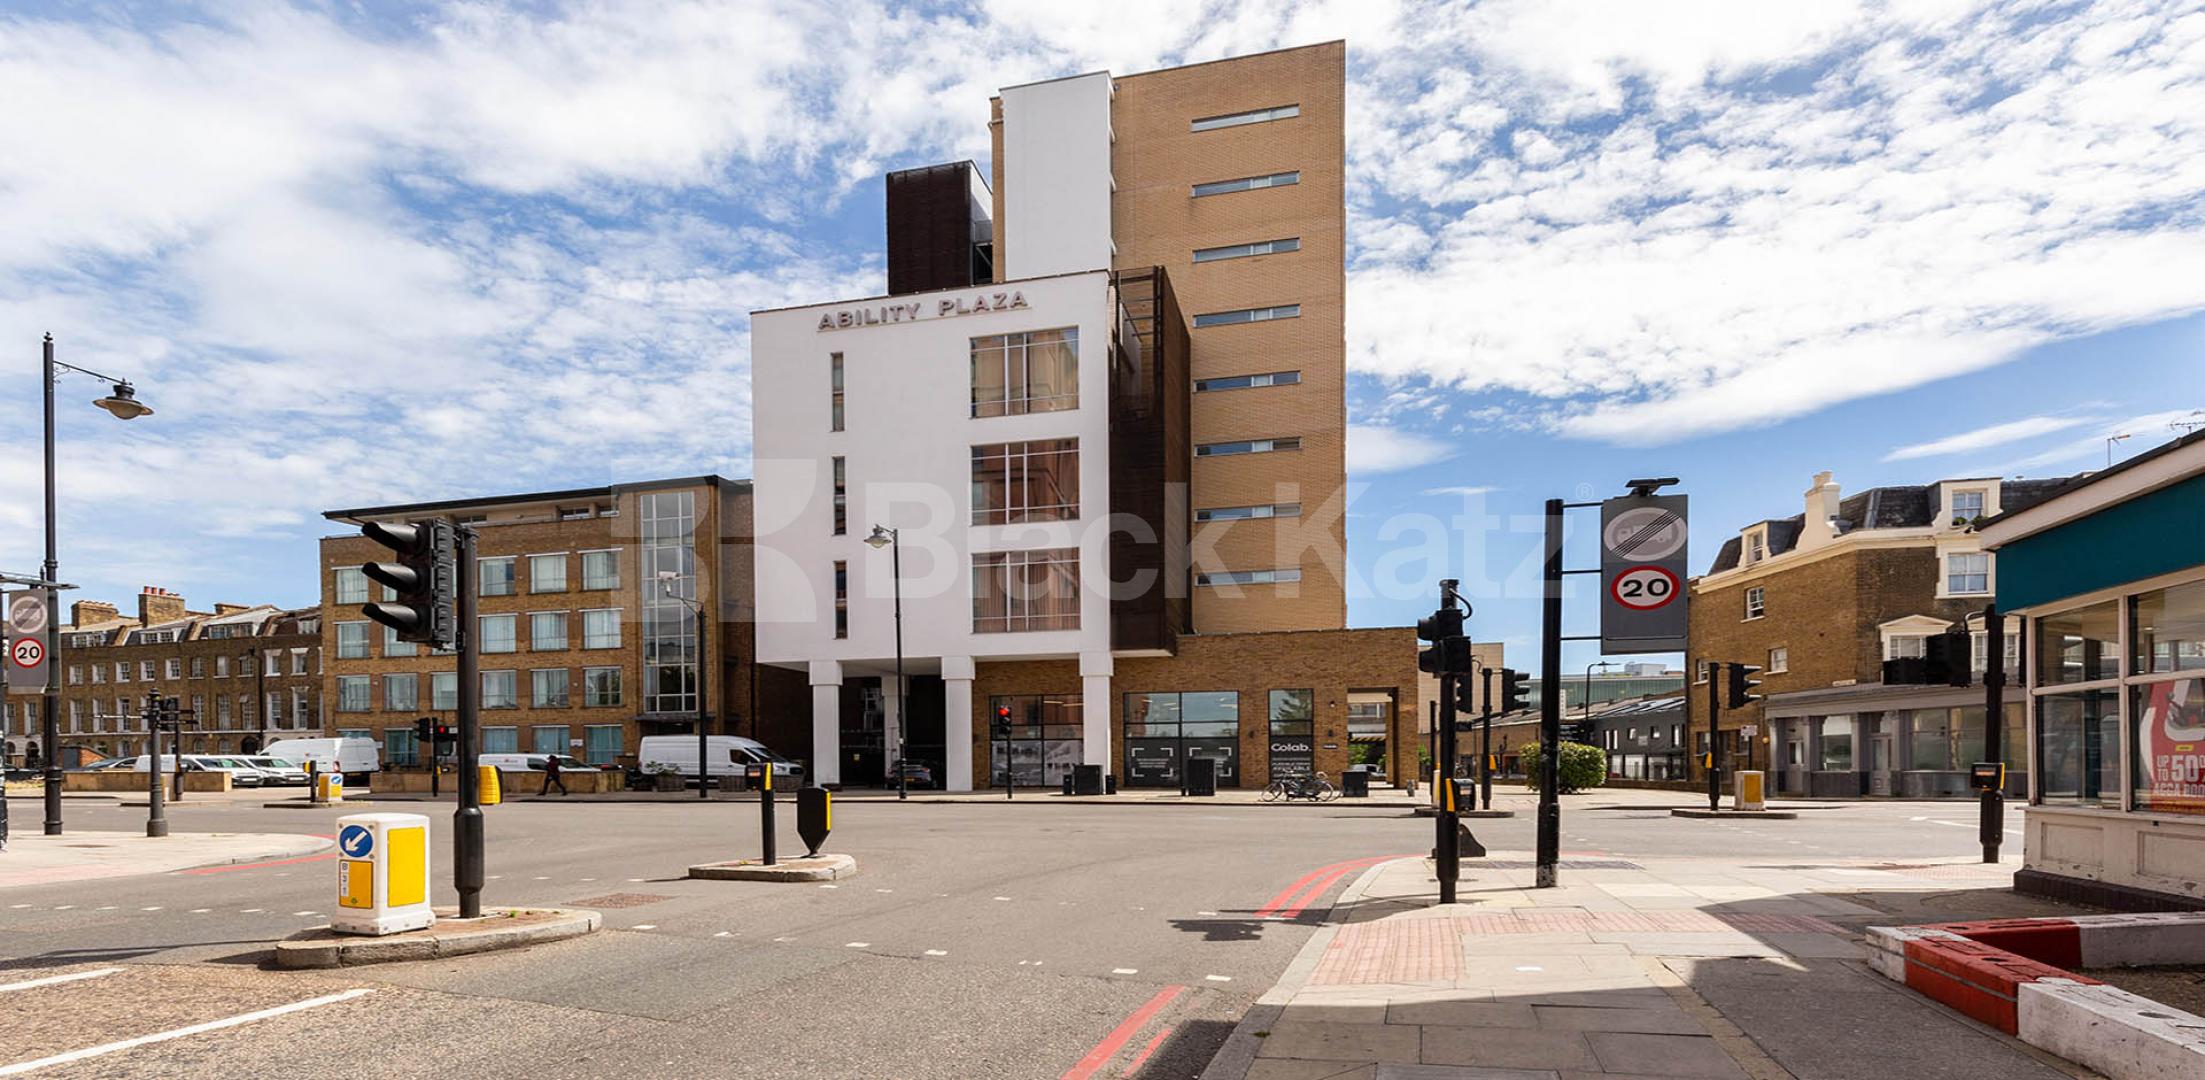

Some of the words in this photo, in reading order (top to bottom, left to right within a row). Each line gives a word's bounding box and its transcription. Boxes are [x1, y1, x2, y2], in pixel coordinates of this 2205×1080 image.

[818, 302, 921, 330] ABILITY
[938, 291, 1028, 316] PLAZA
[1622, 578, 1670, 598] 20
[17, 646, 40, 659] 20
[1271, 743, 1312, 752] Colab.
[2156, 754, 2169, 768] UP
